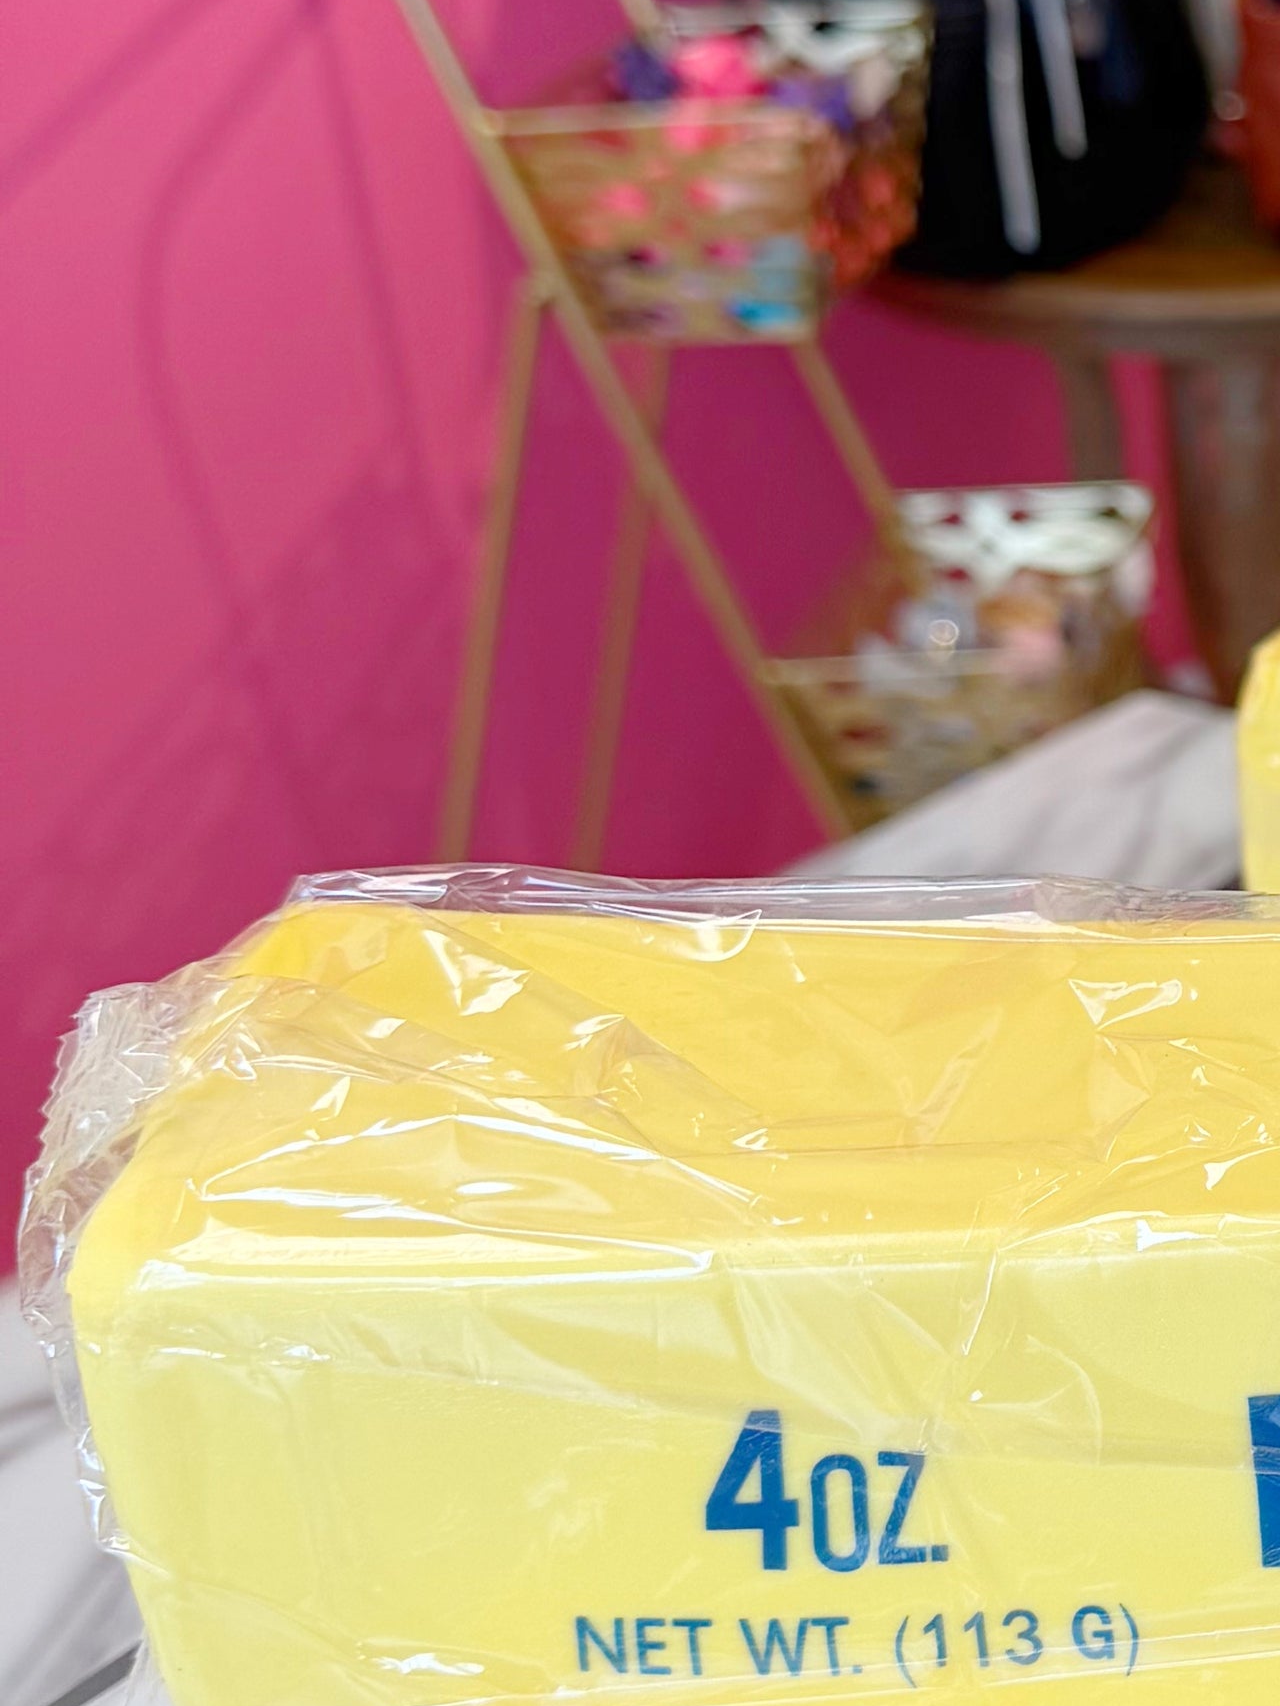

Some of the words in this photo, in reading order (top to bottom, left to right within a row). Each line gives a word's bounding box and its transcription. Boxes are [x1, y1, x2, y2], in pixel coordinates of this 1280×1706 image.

[574, 1615, 714, 1677] NET
[738, 1615, 863, 1678] WT.
[894, 1608, 1045, 1688] (113
[1071, 1603, 1141, 1677] G)
